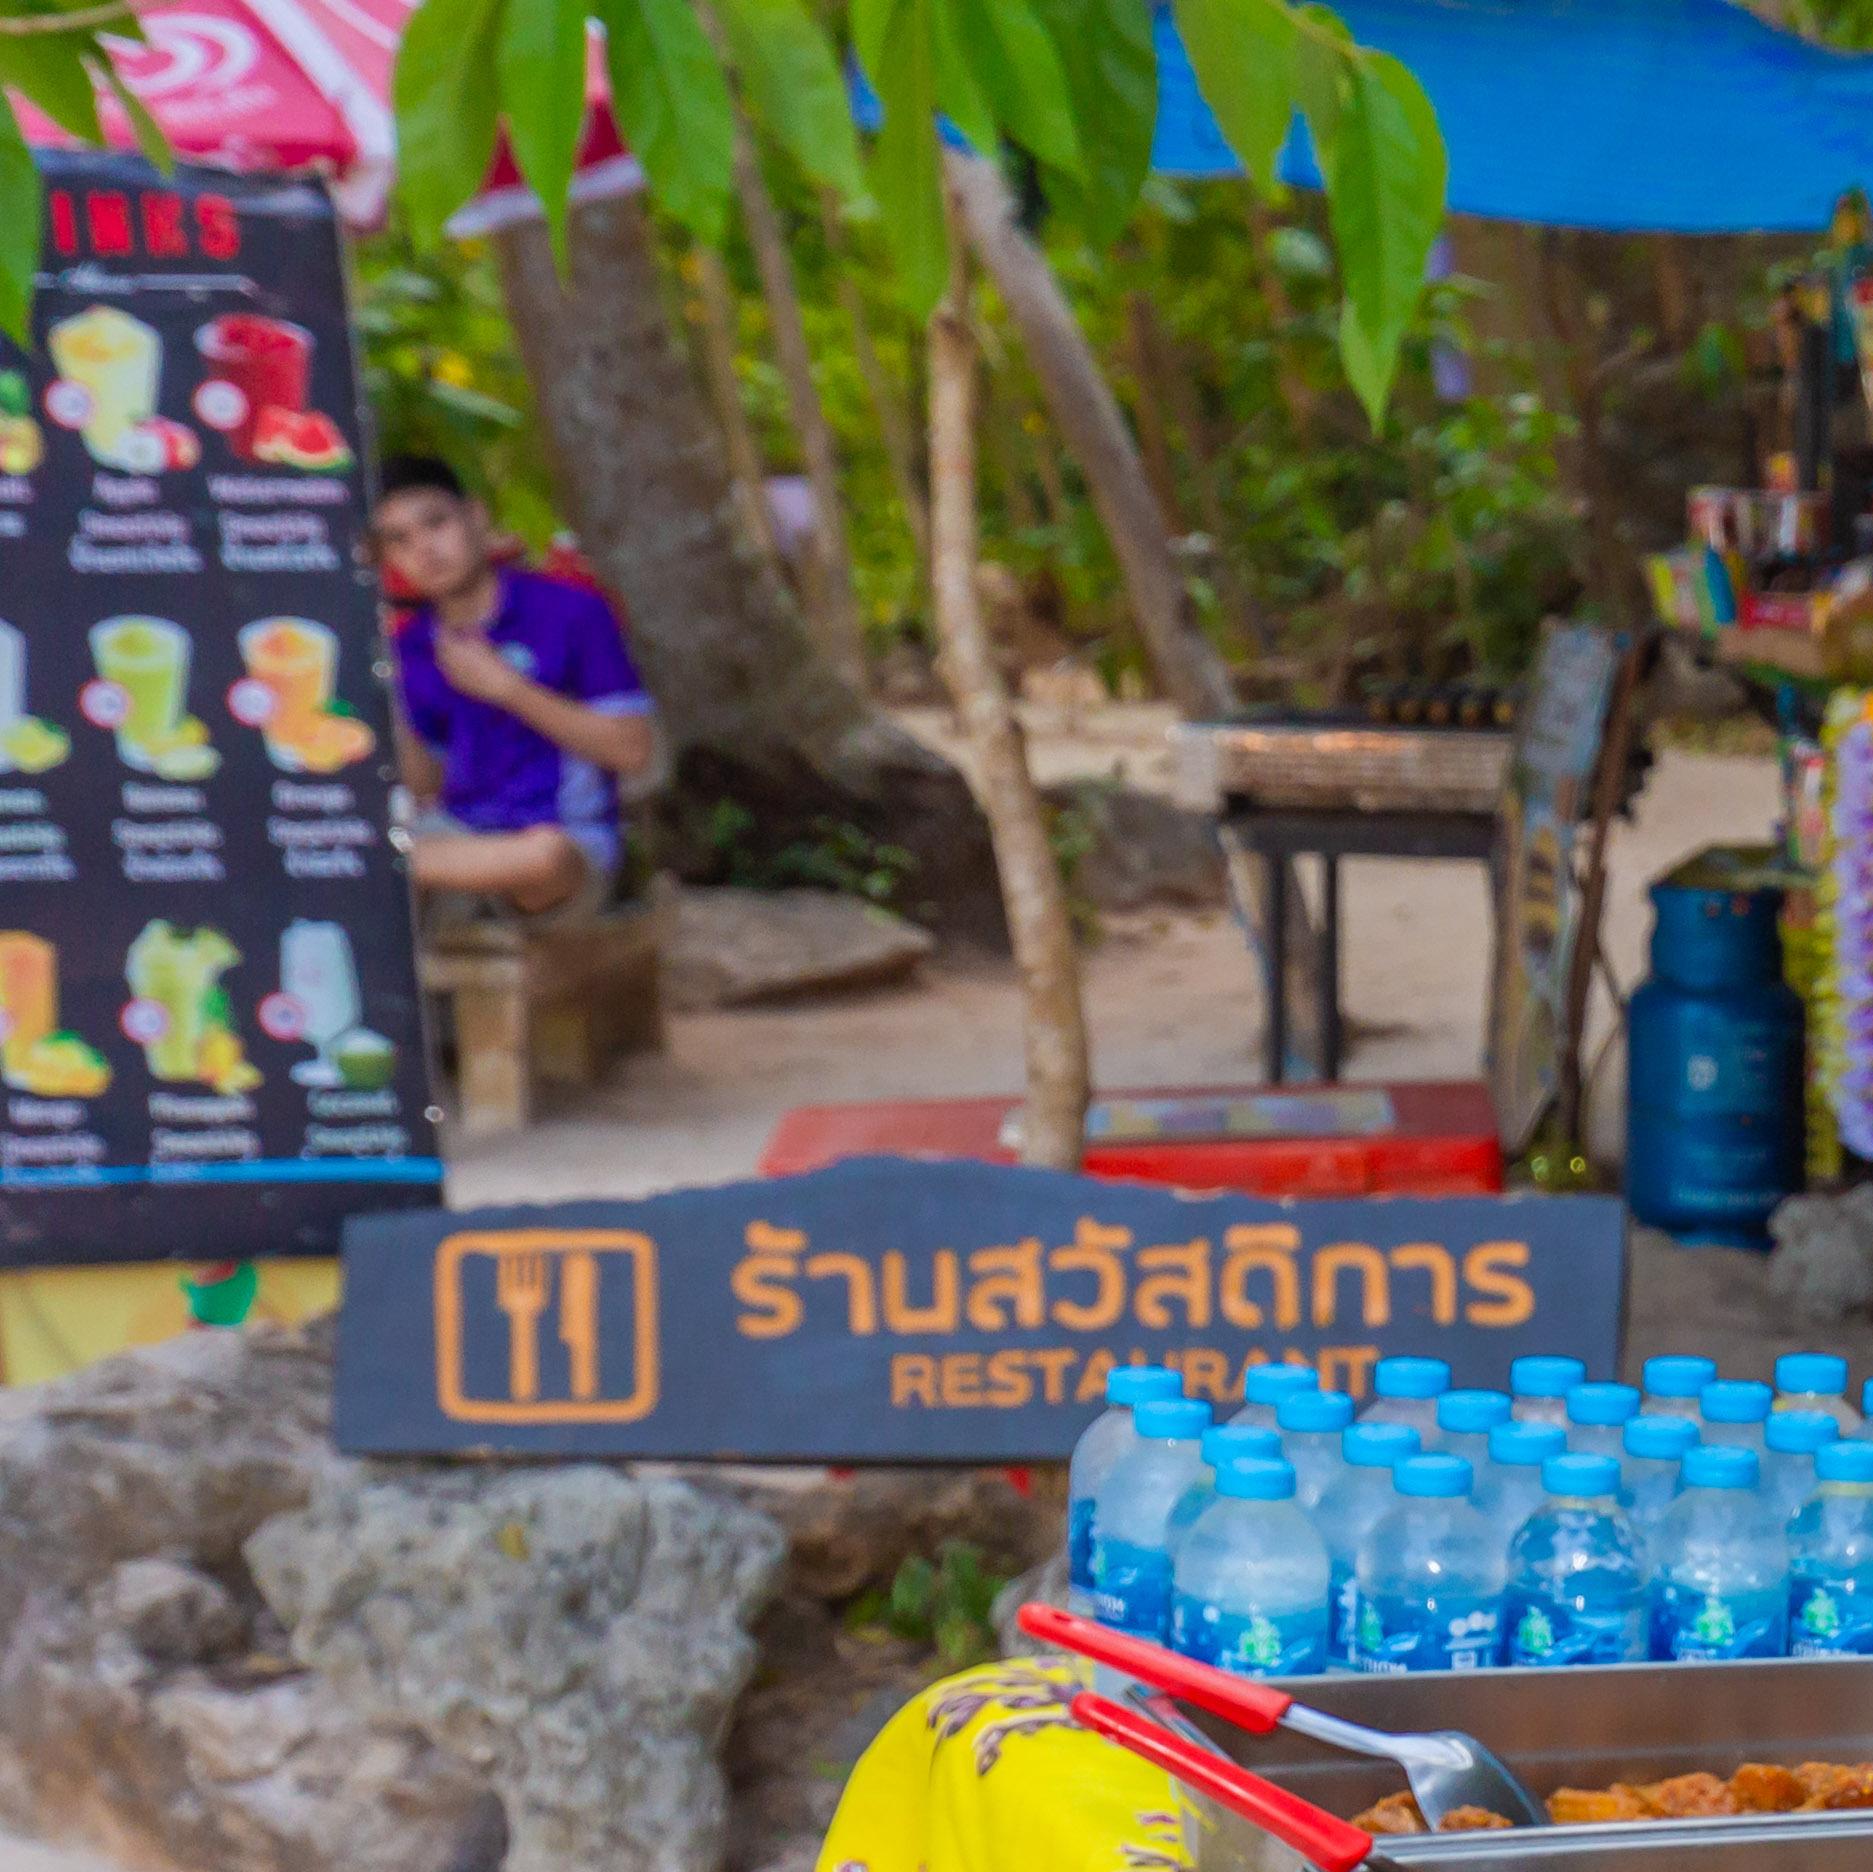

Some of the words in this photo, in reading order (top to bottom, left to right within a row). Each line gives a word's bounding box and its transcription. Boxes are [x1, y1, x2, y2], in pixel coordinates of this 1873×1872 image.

[730, 1217, 1535, 1340] ร้านสวัสดิการ
[890, 1344, 1381, 1407] RESTARNT
